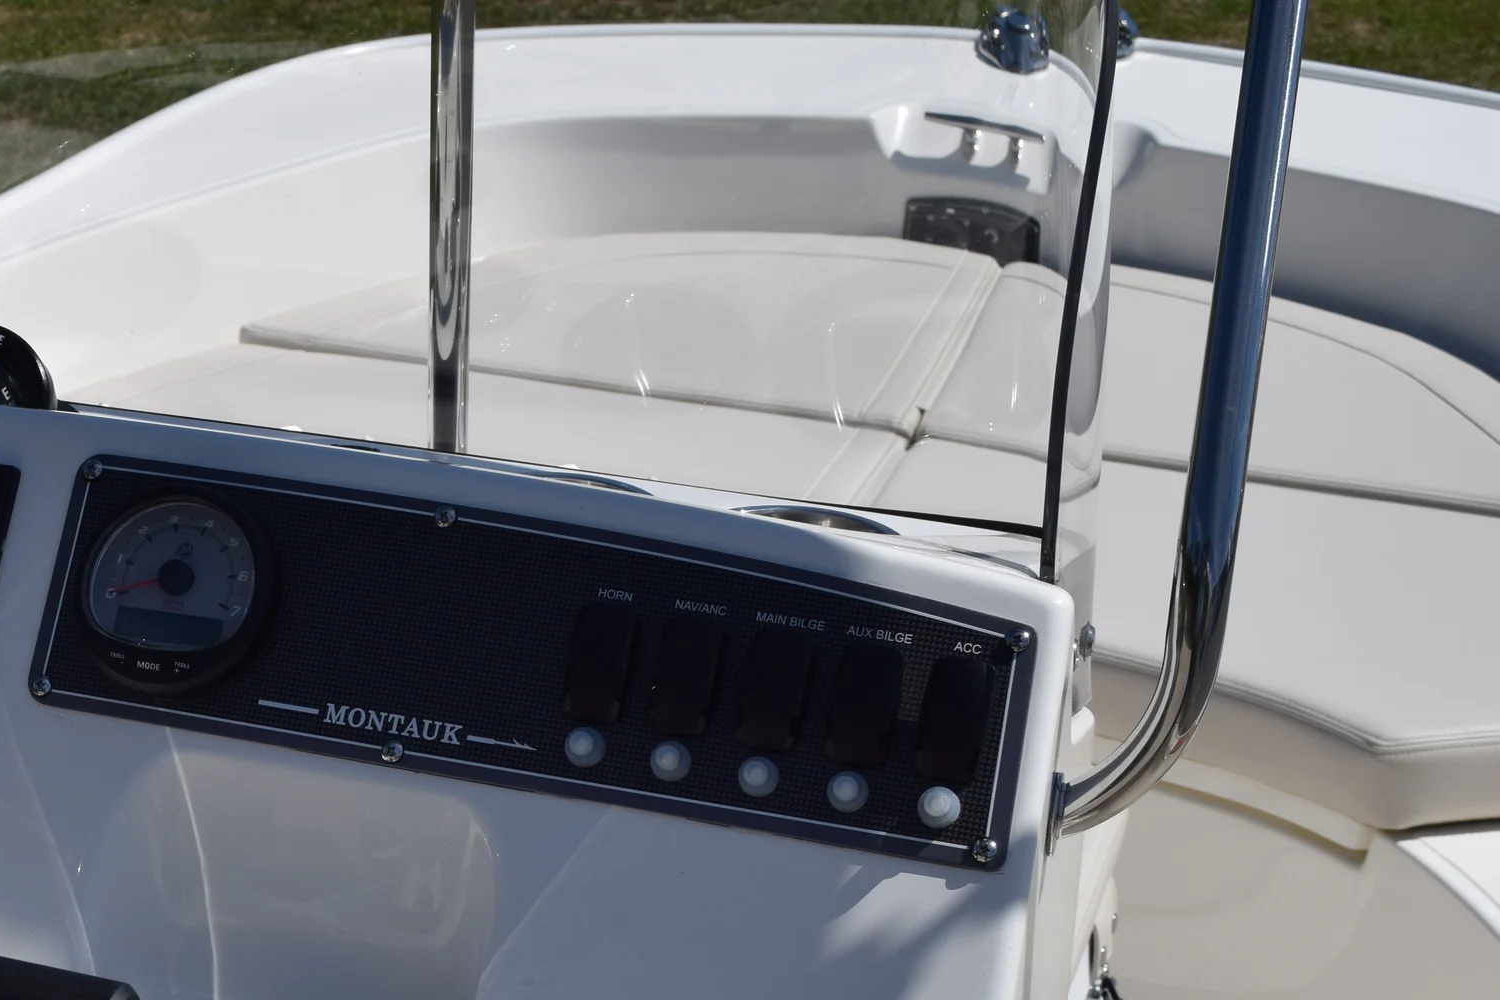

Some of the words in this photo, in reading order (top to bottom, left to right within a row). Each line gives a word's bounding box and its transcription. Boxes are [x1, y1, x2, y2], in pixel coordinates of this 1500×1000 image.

[168, 515, 180, 524] 3
[203, 520, 215, 529] 4
[138, 525, 149, 535] 2
[230, 538, 240, 547] 5
[116, 553, 124, 564] 1
[238, 571, 249, 582] 6
[597, 587, 633, 602] HORN
[230, 605, 242, 617] 7
[674, 599, 727, 616] NAV/ANC
[755, 611, 787, 625] MAIN
[789, 616, 826, 631] BILGE
[846, 625, 873, 639] AUX
[875, 629, 914, 645] BILGE
[953, 641, 982, 655] ACC
[110, 651, 126, 660] TROLL
[136, 660, 161, 672] MODE
[174, 661, 191, 670] TROLL
[322, 702, 464, 746] MONTAUK
